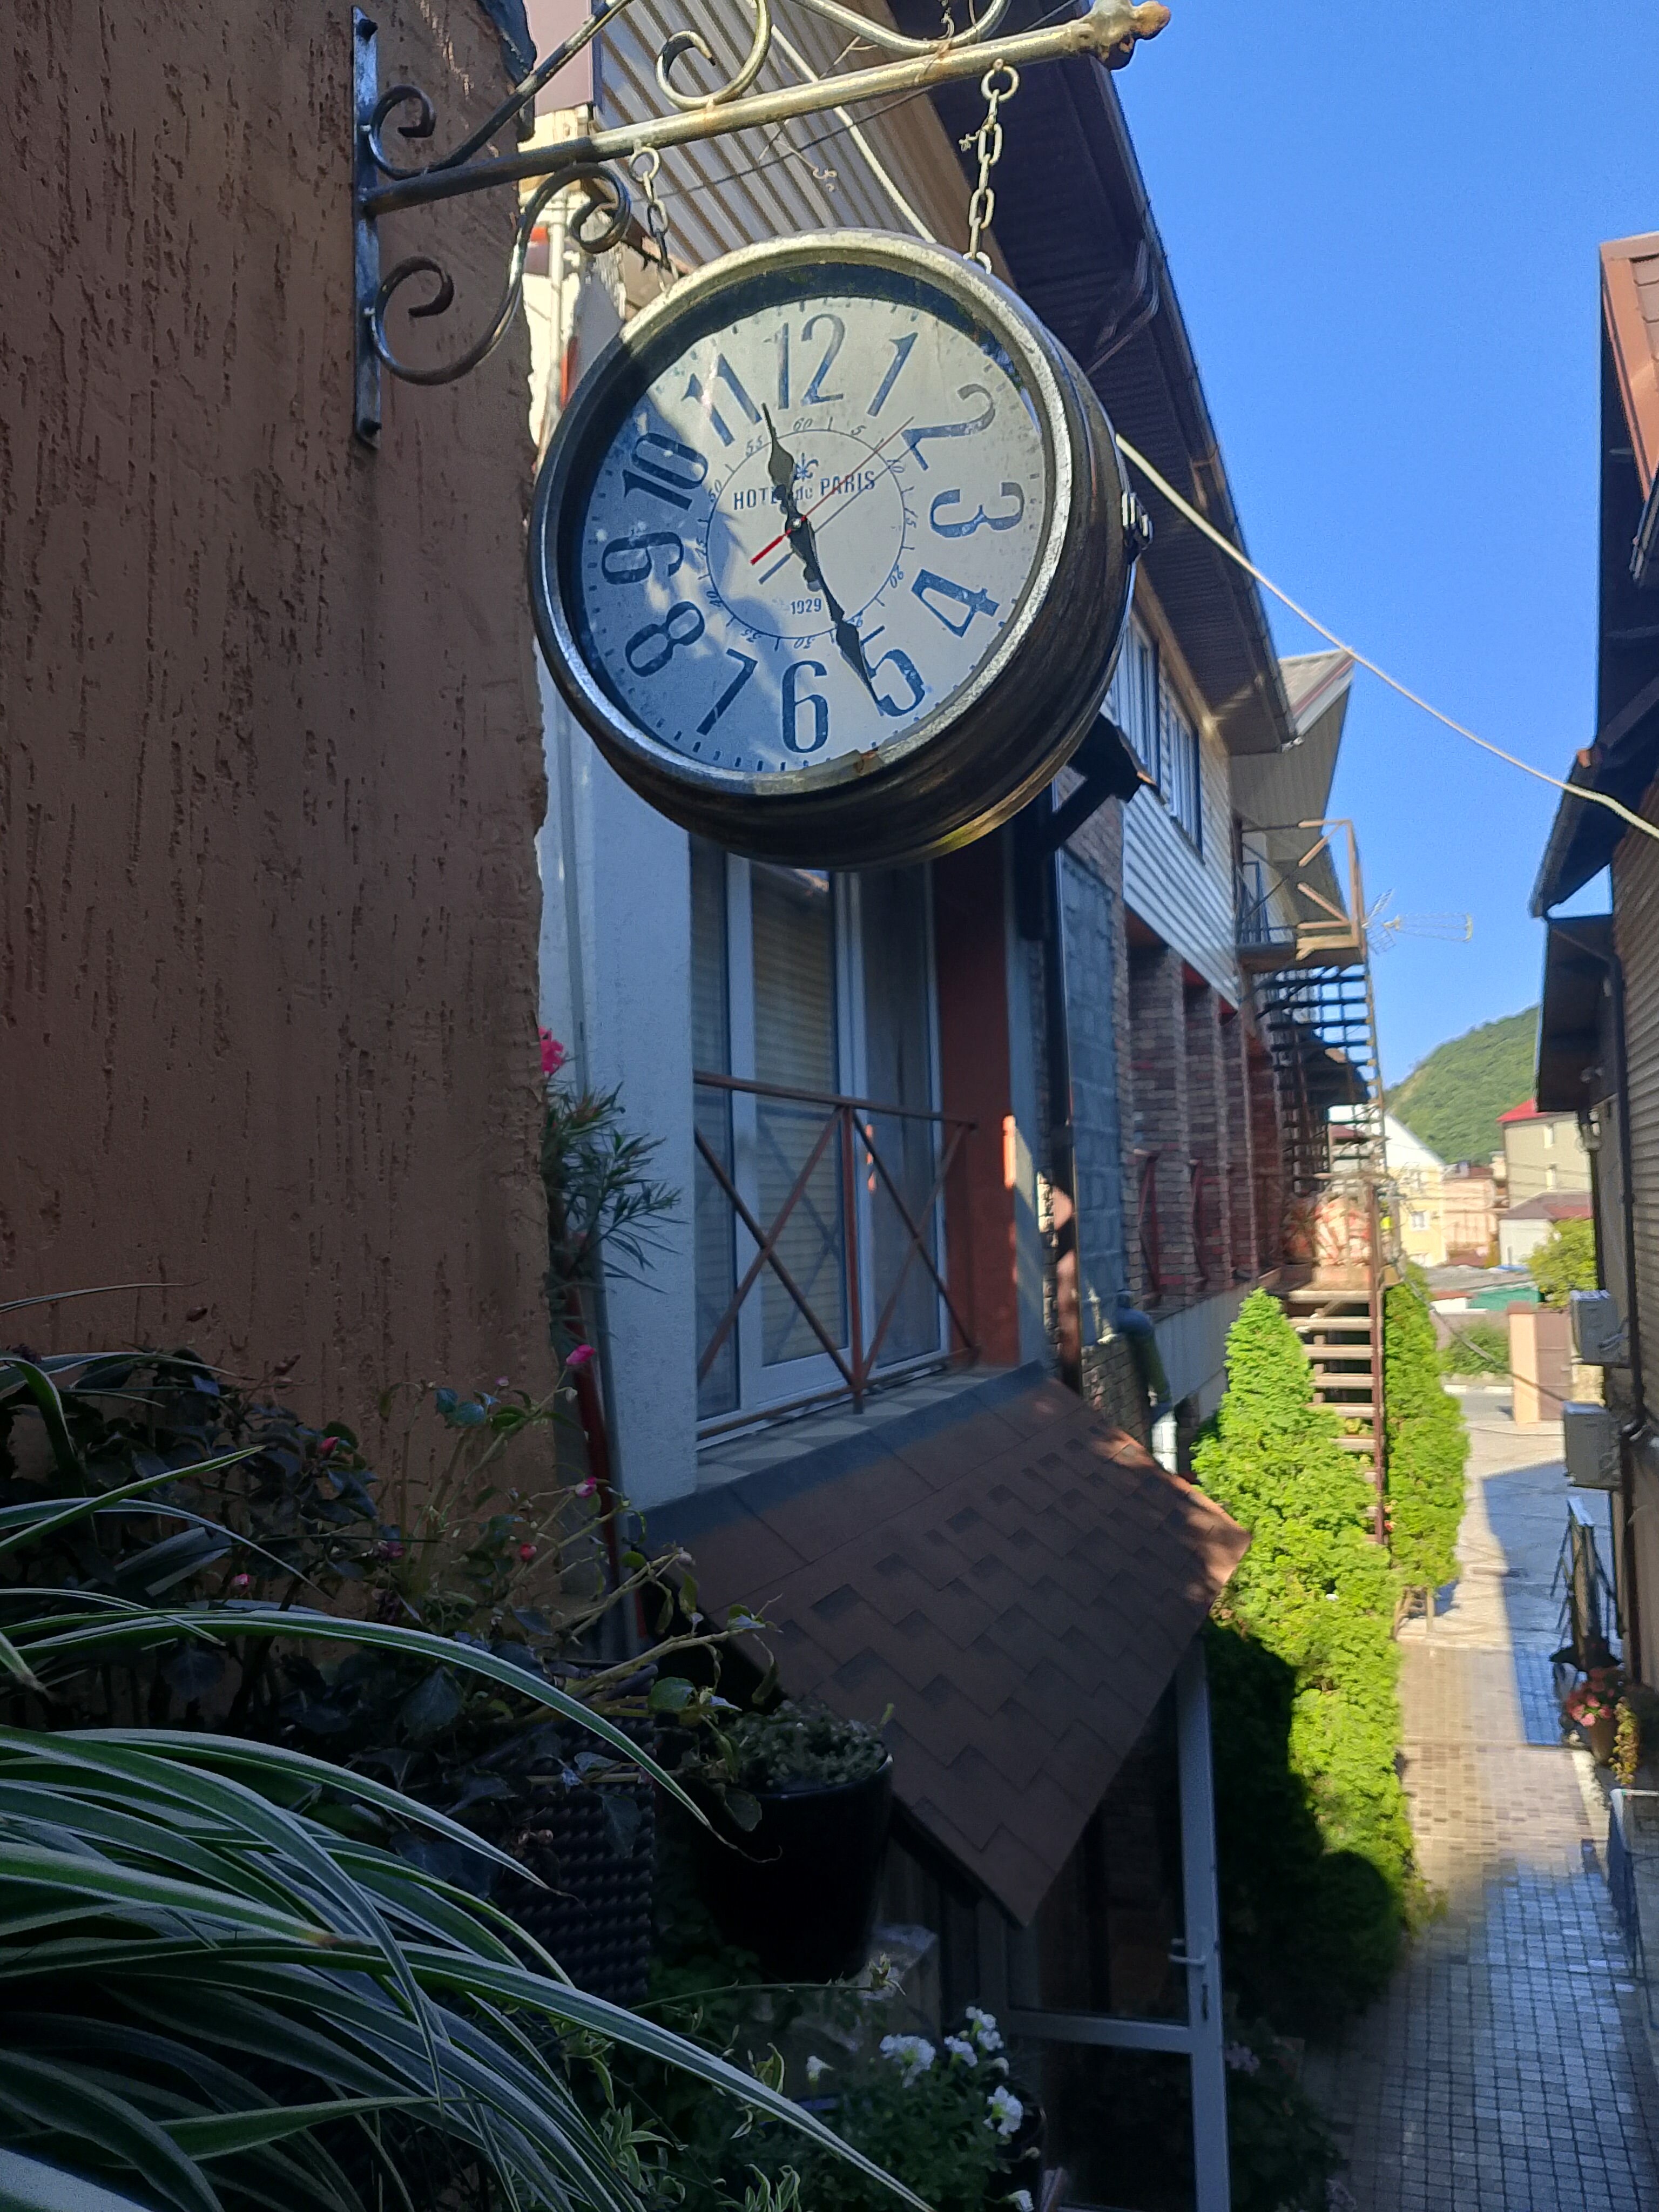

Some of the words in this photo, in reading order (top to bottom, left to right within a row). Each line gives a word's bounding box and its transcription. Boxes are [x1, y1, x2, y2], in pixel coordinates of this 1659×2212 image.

[680, 352, 763, 447] 11
[763, 313, 846, 410] 12
[866, 332, 919, 417] 1
[900, 383, 996, 471] 2
[623, 432, 709, 511] 10
[820, 470, 875, 496] PARIS
[930, 482, 1025, 538] 3
[602, 531, 685, 585] 9
[625, 601, 705, 677] 8
[790, 597, 822, 615] 1929
[911, 569, 1000, 638] 4
[696, 648, 758, 736] 7
[782, 659, 829, 753] 6
[860, 624, 926, 717] 5
